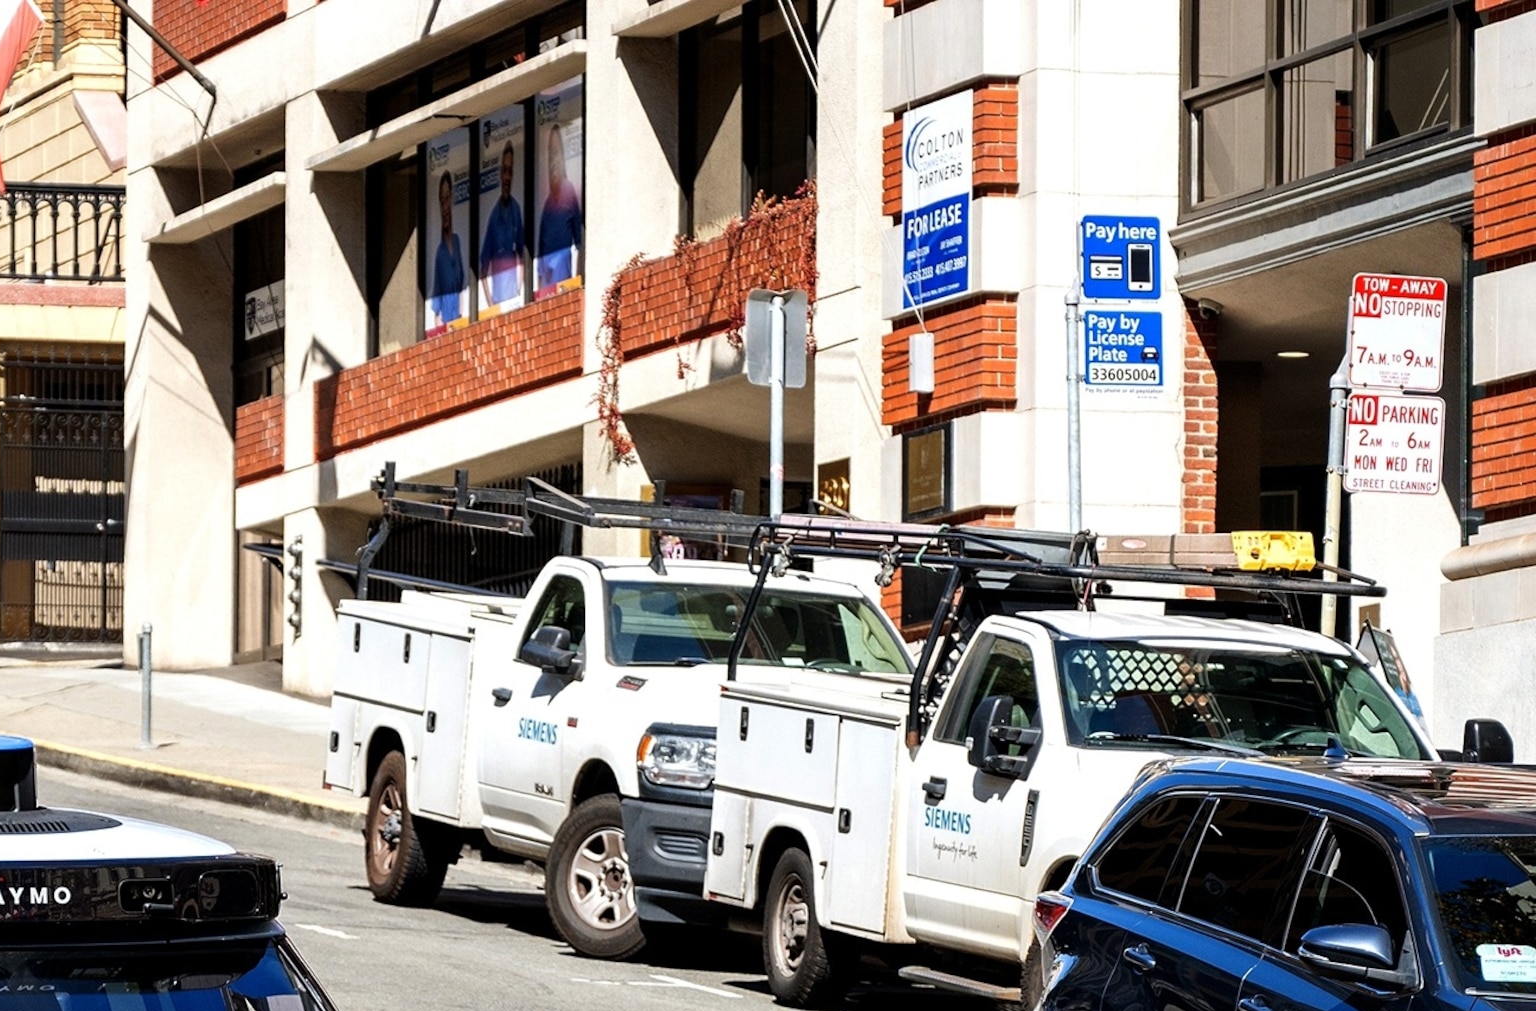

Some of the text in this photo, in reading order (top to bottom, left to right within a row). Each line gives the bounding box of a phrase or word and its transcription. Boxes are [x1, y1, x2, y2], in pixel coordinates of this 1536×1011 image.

[918, 128, 964, 158] COLTON
[918, 162, 962, 189] PARTNERS
[907, 203, 962, 239] FOR LEASE
[1086, 222, 1157, 243] Pay here
[1355, 292, 1441, 318] NO STOPPING
[1088, 313, 1140, 333] Pay by
[1089, 330, 1145, 346] License
[1089, 346, 1128, 362] Plate
[1392, 354, 1402, 363] TO
[1091, 368, 1157, 381] 33605004
[1352, 397, 1439, 425] NO PARKING
[1359, 429, 1383, 448] 2AM
[1407, 432, 1431, 449] 6AM
[1354, 455, 1433, 473] MON WED FRI
[1353, 478, 1432, 491] STREET CLEANING
[518, 717, 558, 745] SIEMENS
[924, 806, 972, 835] SIEMENS
[1497, 946, 1522, 957] lyft
